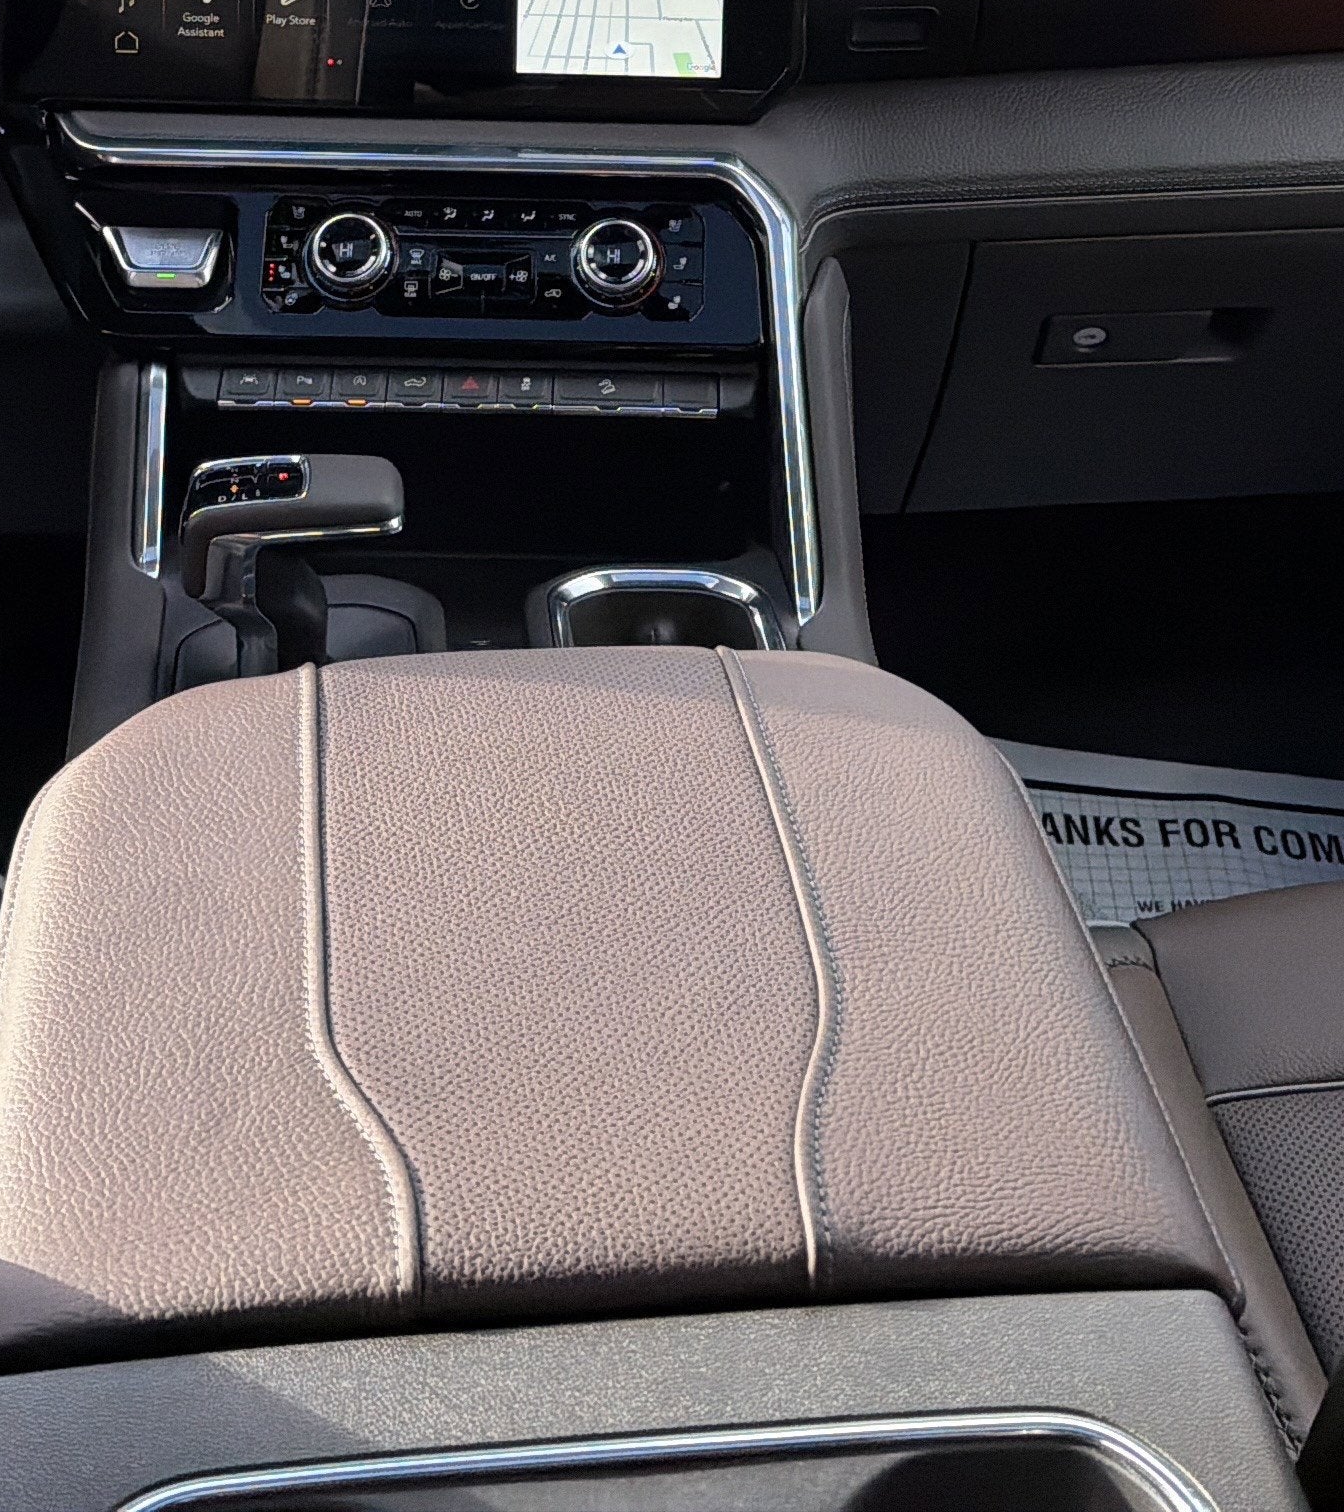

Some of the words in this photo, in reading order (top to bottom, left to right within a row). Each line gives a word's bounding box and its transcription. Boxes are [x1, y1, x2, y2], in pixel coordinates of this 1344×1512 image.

[182, 12, 220, 25] Google
[266, 14, 287, 27] Play
[289, 14, 316, 26] Store
[177, 26, 225, 38] Assistant
[558, 213, 576, 222] SYNC
[339, 242, 354, 258] HI
[607, 248, 621, 264] HI
[544, 254, 557, 262] A/C
[470, 273, 496, 281] ON/OFF
[1041, 810, 1145, 848] ANKS
[1158, 816, 1241, 850] FOR
[1136, 900, 1164, 913] WE
